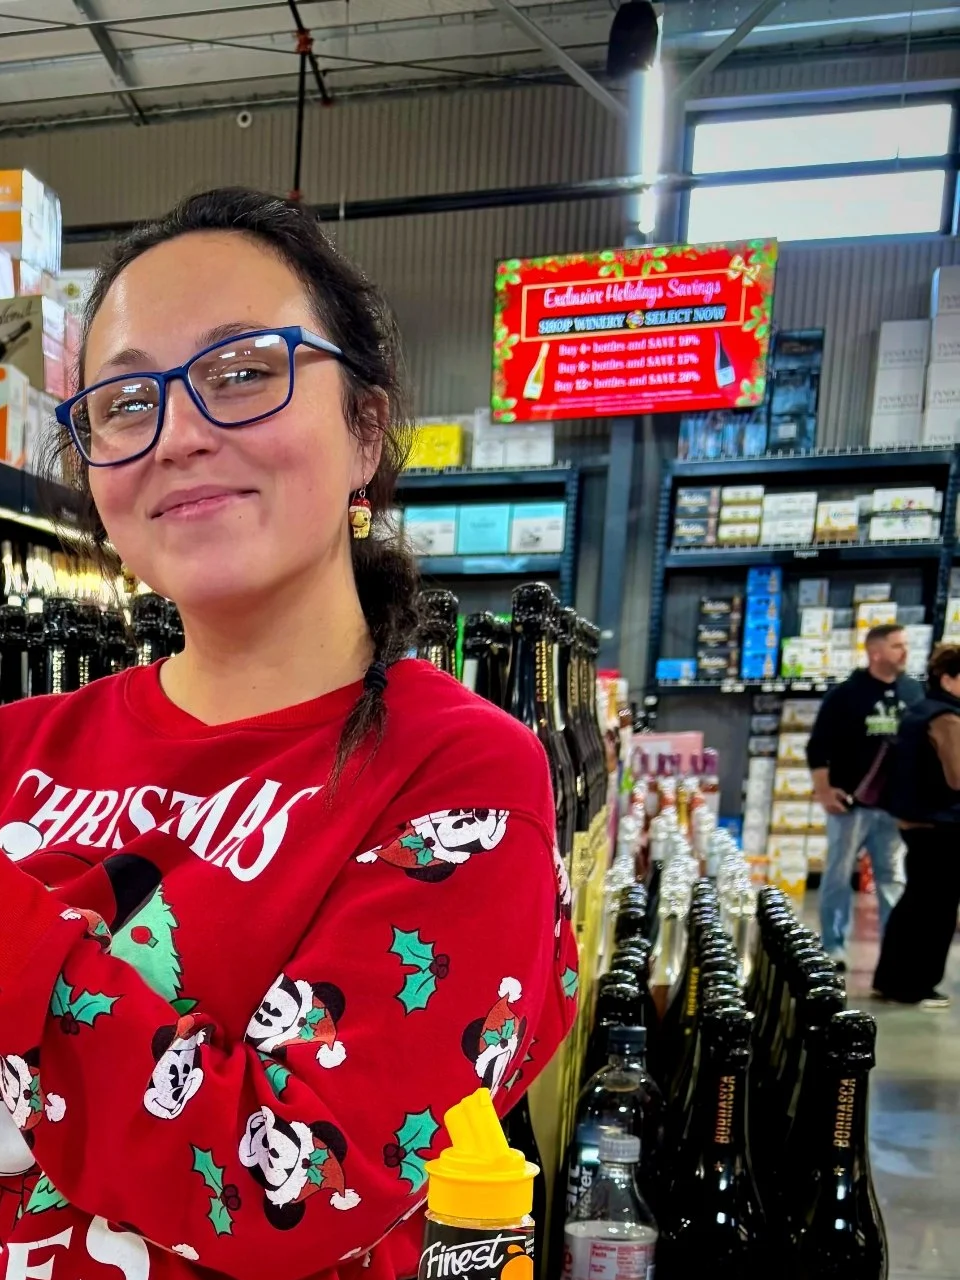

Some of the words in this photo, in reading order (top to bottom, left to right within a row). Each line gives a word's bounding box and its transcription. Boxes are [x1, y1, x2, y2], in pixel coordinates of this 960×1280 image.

[544, 285, 604, 308] Exclusive
[666, 278, 721, 304] Savings
[539, 317, 573, 334] SHOP
[574, 313, 626, 331] WINERY
[645, 308, 692, 325] SELECT
[693, 305, 727, 321] NOW
[559, 344, 578, 357] Buy
[593, 341, 625, 353] bottles
[627, 339, 646, 351] and
[647, 337, 676, 349] SAVE
[558, 362, 577, 375] Buy
[592, 360, 624, 371] bottles
[626, 357, 645, 369] and
[646, 355, 675, 367] SAVE
[554, 380, 574, 393] Buy
[594, 377, 626, 389] bottles
[628, 375, 647, 386] and
[648, 373, 676, 385] SAVE
[13, 768, 326, 883] CHRISTMAS
[426, 1233, 527, 1279] Finest
